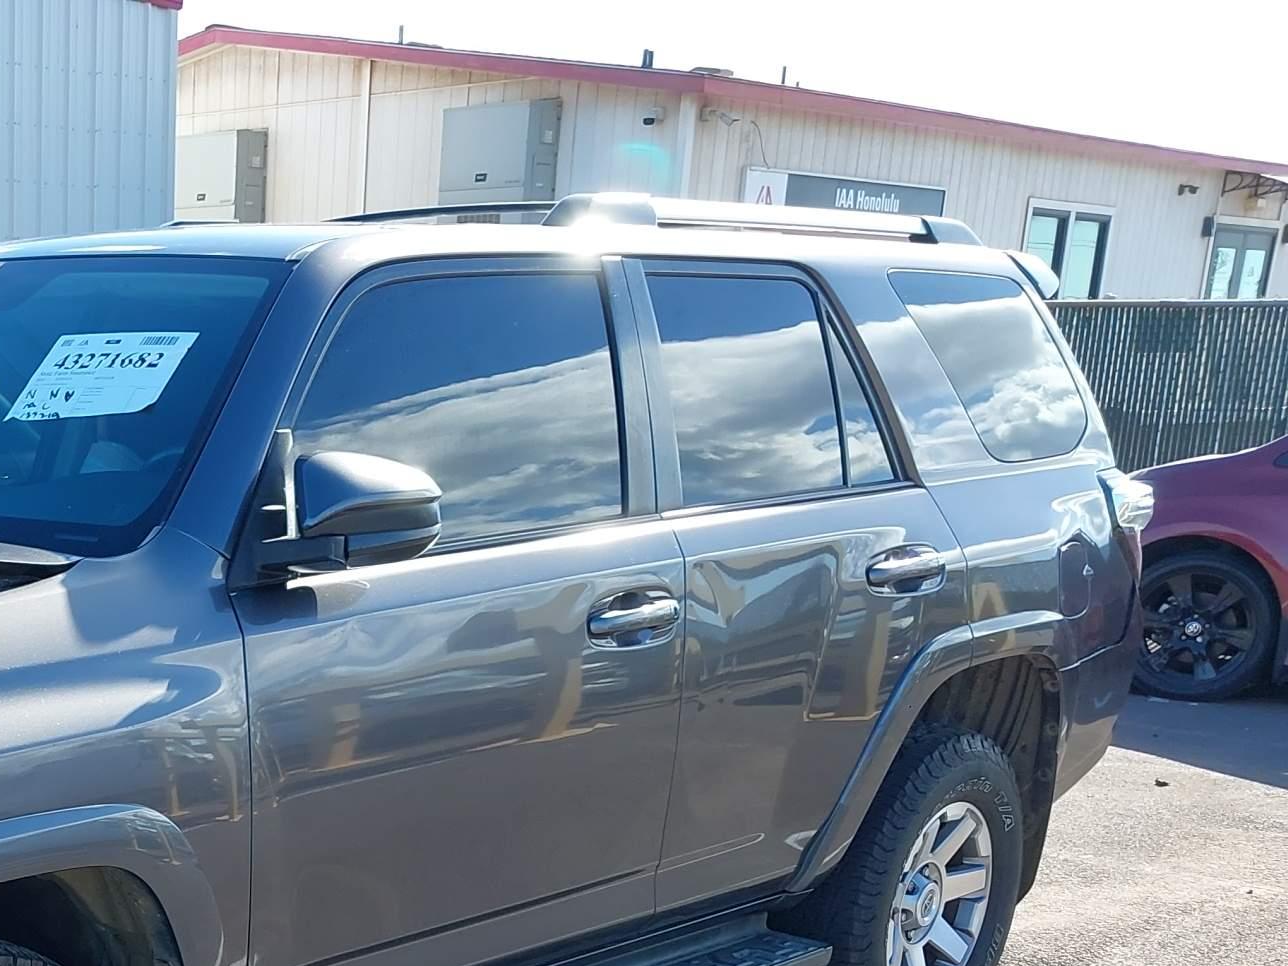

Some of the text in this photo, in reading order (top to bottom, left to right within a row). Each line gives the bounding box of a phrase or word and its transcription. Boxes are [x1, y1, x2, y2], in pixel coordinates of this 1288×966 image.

[835, 188, 900, 213] IAA Honolulu
[53, 352, 164, 369] 43271682
[994, 792, 1015, 832] T/A
